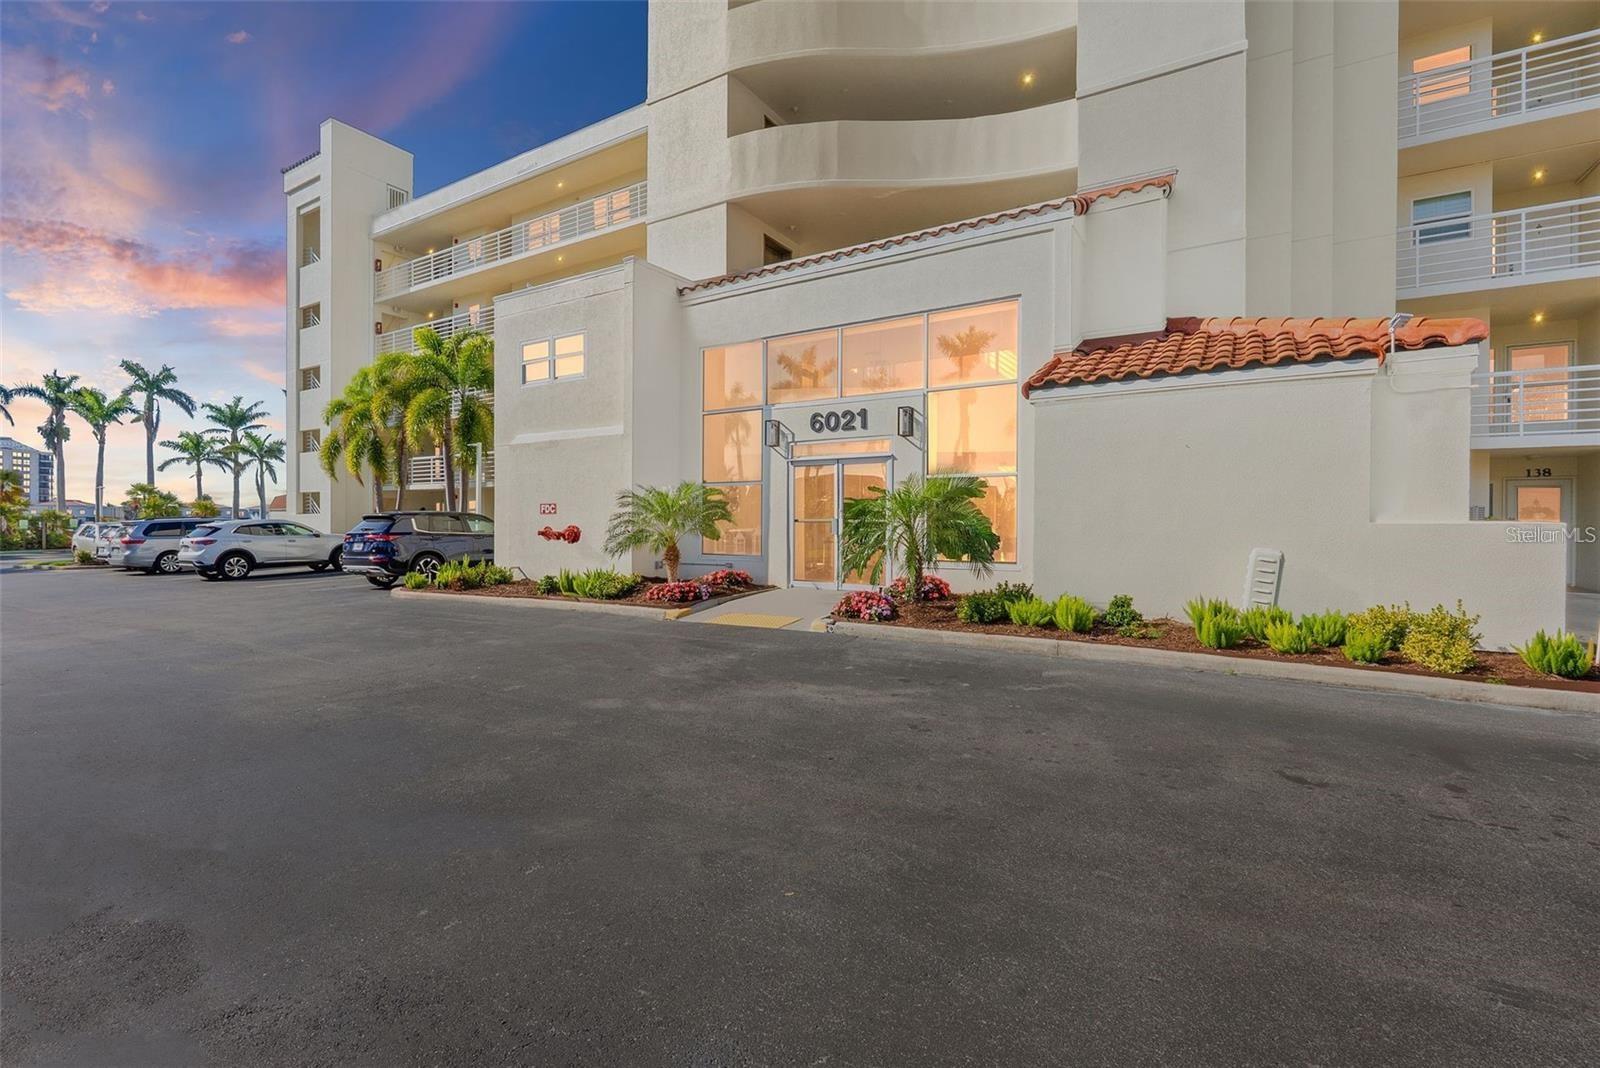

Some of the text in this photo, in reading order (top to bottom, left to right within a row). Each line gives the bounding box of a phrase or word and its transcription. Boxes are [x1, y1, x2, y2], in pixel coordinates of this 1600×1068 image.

[810, 408, 868, 433] 6021
[1526, 467, 1552, 478] 138
[540, 504, 556, 513] FDC
